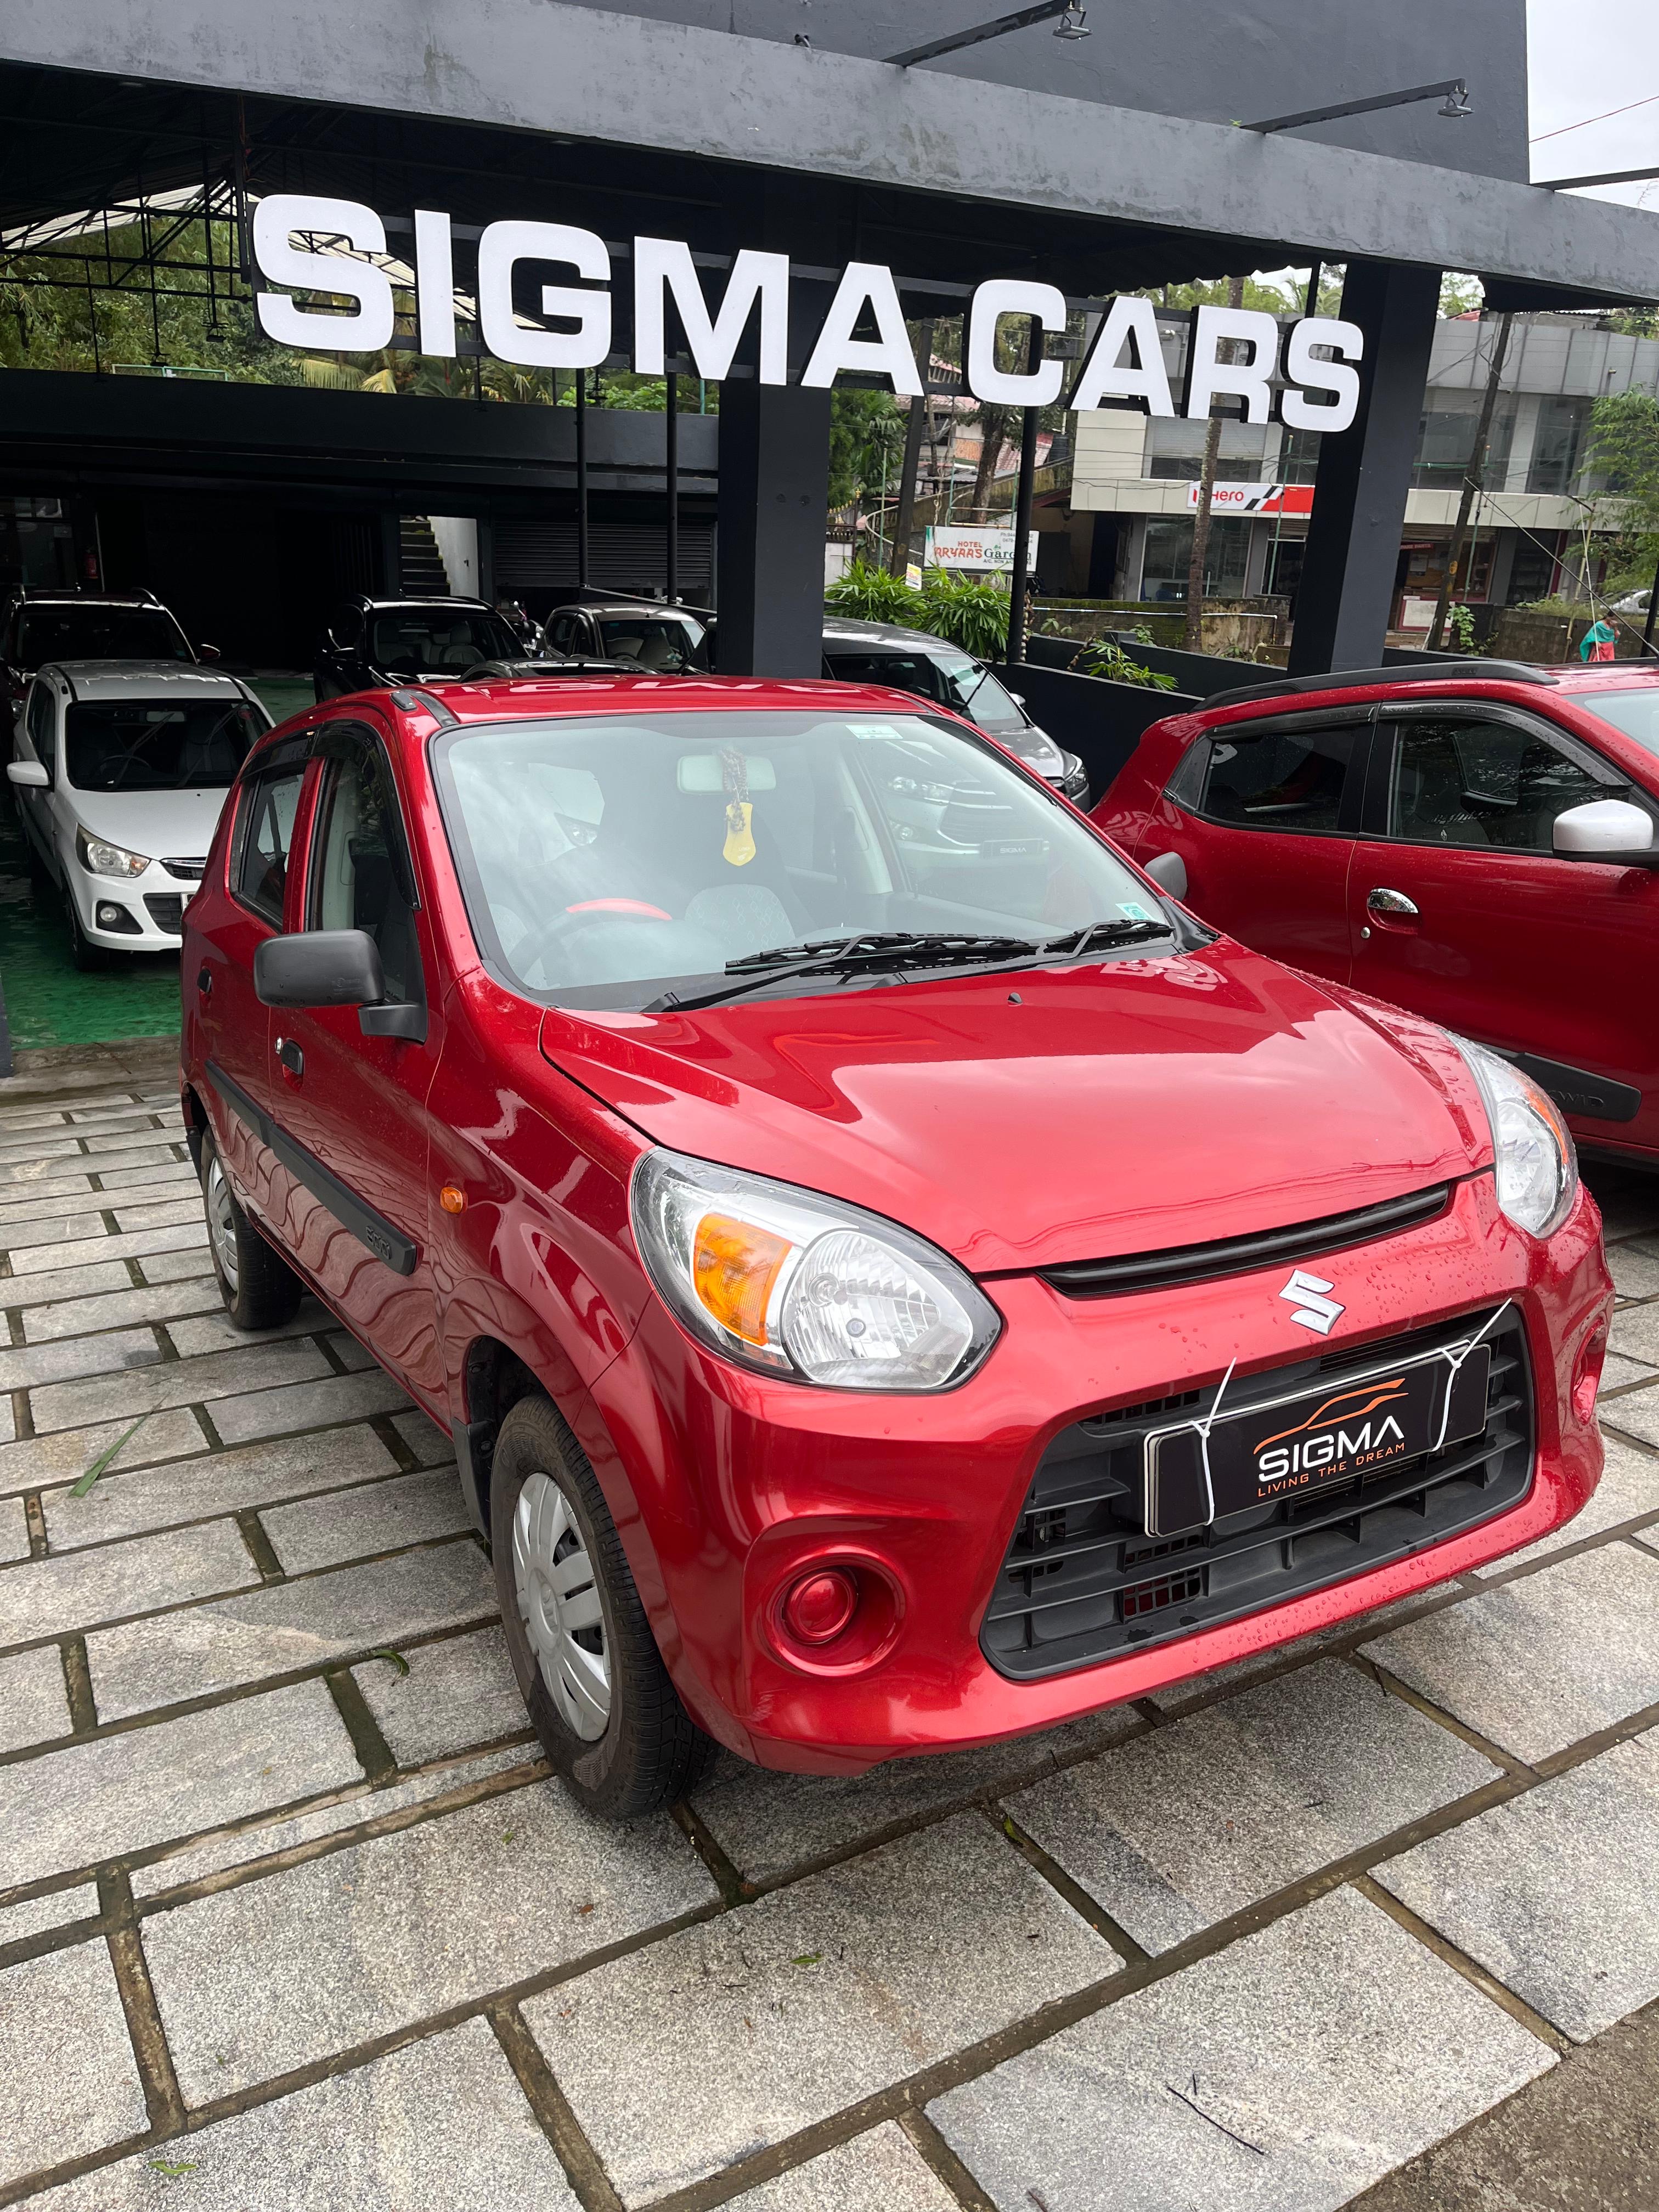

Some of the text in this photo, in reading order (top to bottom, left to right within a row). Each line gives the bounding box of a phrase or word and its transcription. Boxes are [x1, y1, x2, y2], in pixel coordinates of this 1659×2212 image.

[253, 194, 1364, 432] SIGMA CARS
[934, 546, 983, 558] ARYAAS
[1258, 1442, 1405, 1497] LIVING THE DREAM
[1259, 1415, 1405, 1482] SIGMA
